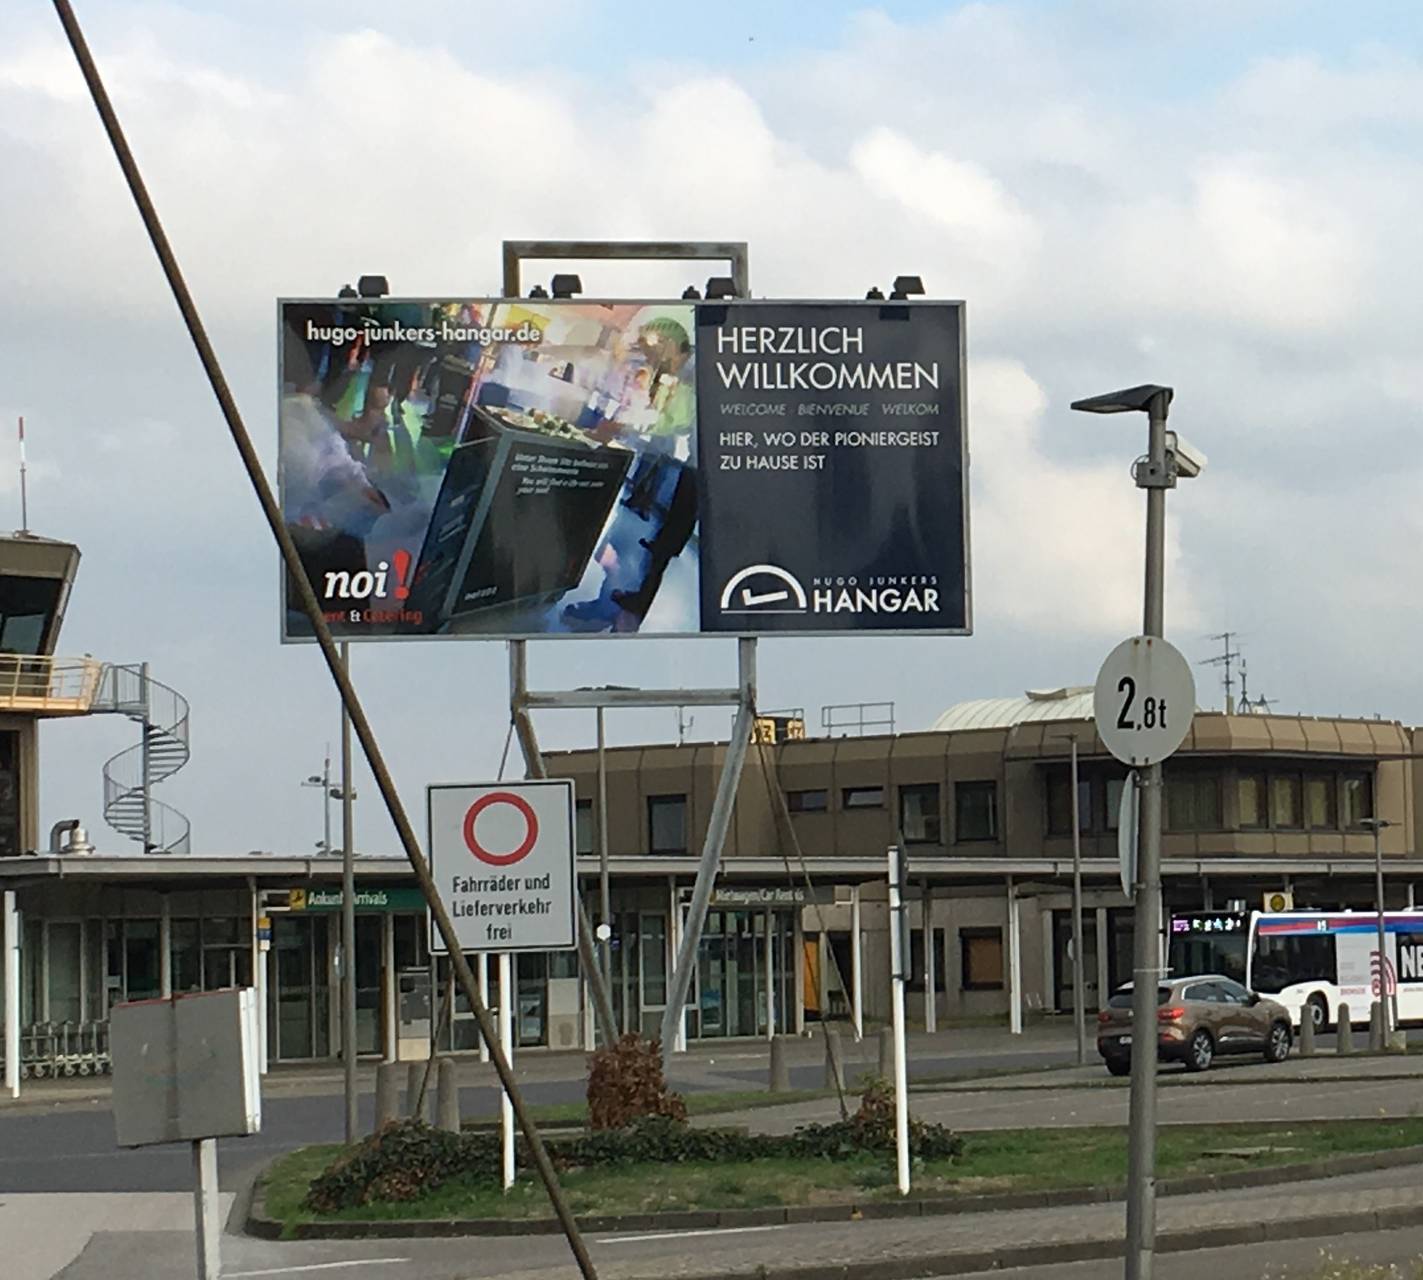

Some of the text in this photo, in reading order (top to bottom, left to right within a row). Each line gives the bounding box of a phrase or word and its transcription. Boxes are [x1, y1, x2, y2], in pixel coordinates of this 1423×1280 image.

[306, 319, 541, 346] hugo-junkers-hangar.de
[717, 326, 863, 354] HERZLICH
[715, 361, 940, 390] WILLKOMMEN
[720, 402, 939, 416] WELCOME BIENVENUE WELKOM
[719, 431, 940, 448] HIER, WO DER PIONIERGEIST
[719, 455, 826, 470] ZU HAUSE IST
[812, 576, 938, 586] HUGO JUNKERS
[812, 588, 940, 614] HANGAR
[350, 609, 361, 623] &
[363, 608, 424, 625] Catering
[452, 872, 551, 893] Fahrräder und
[452, 897, 552, 918] Lieferverkehr
[486, 922, 513, 941] frei
